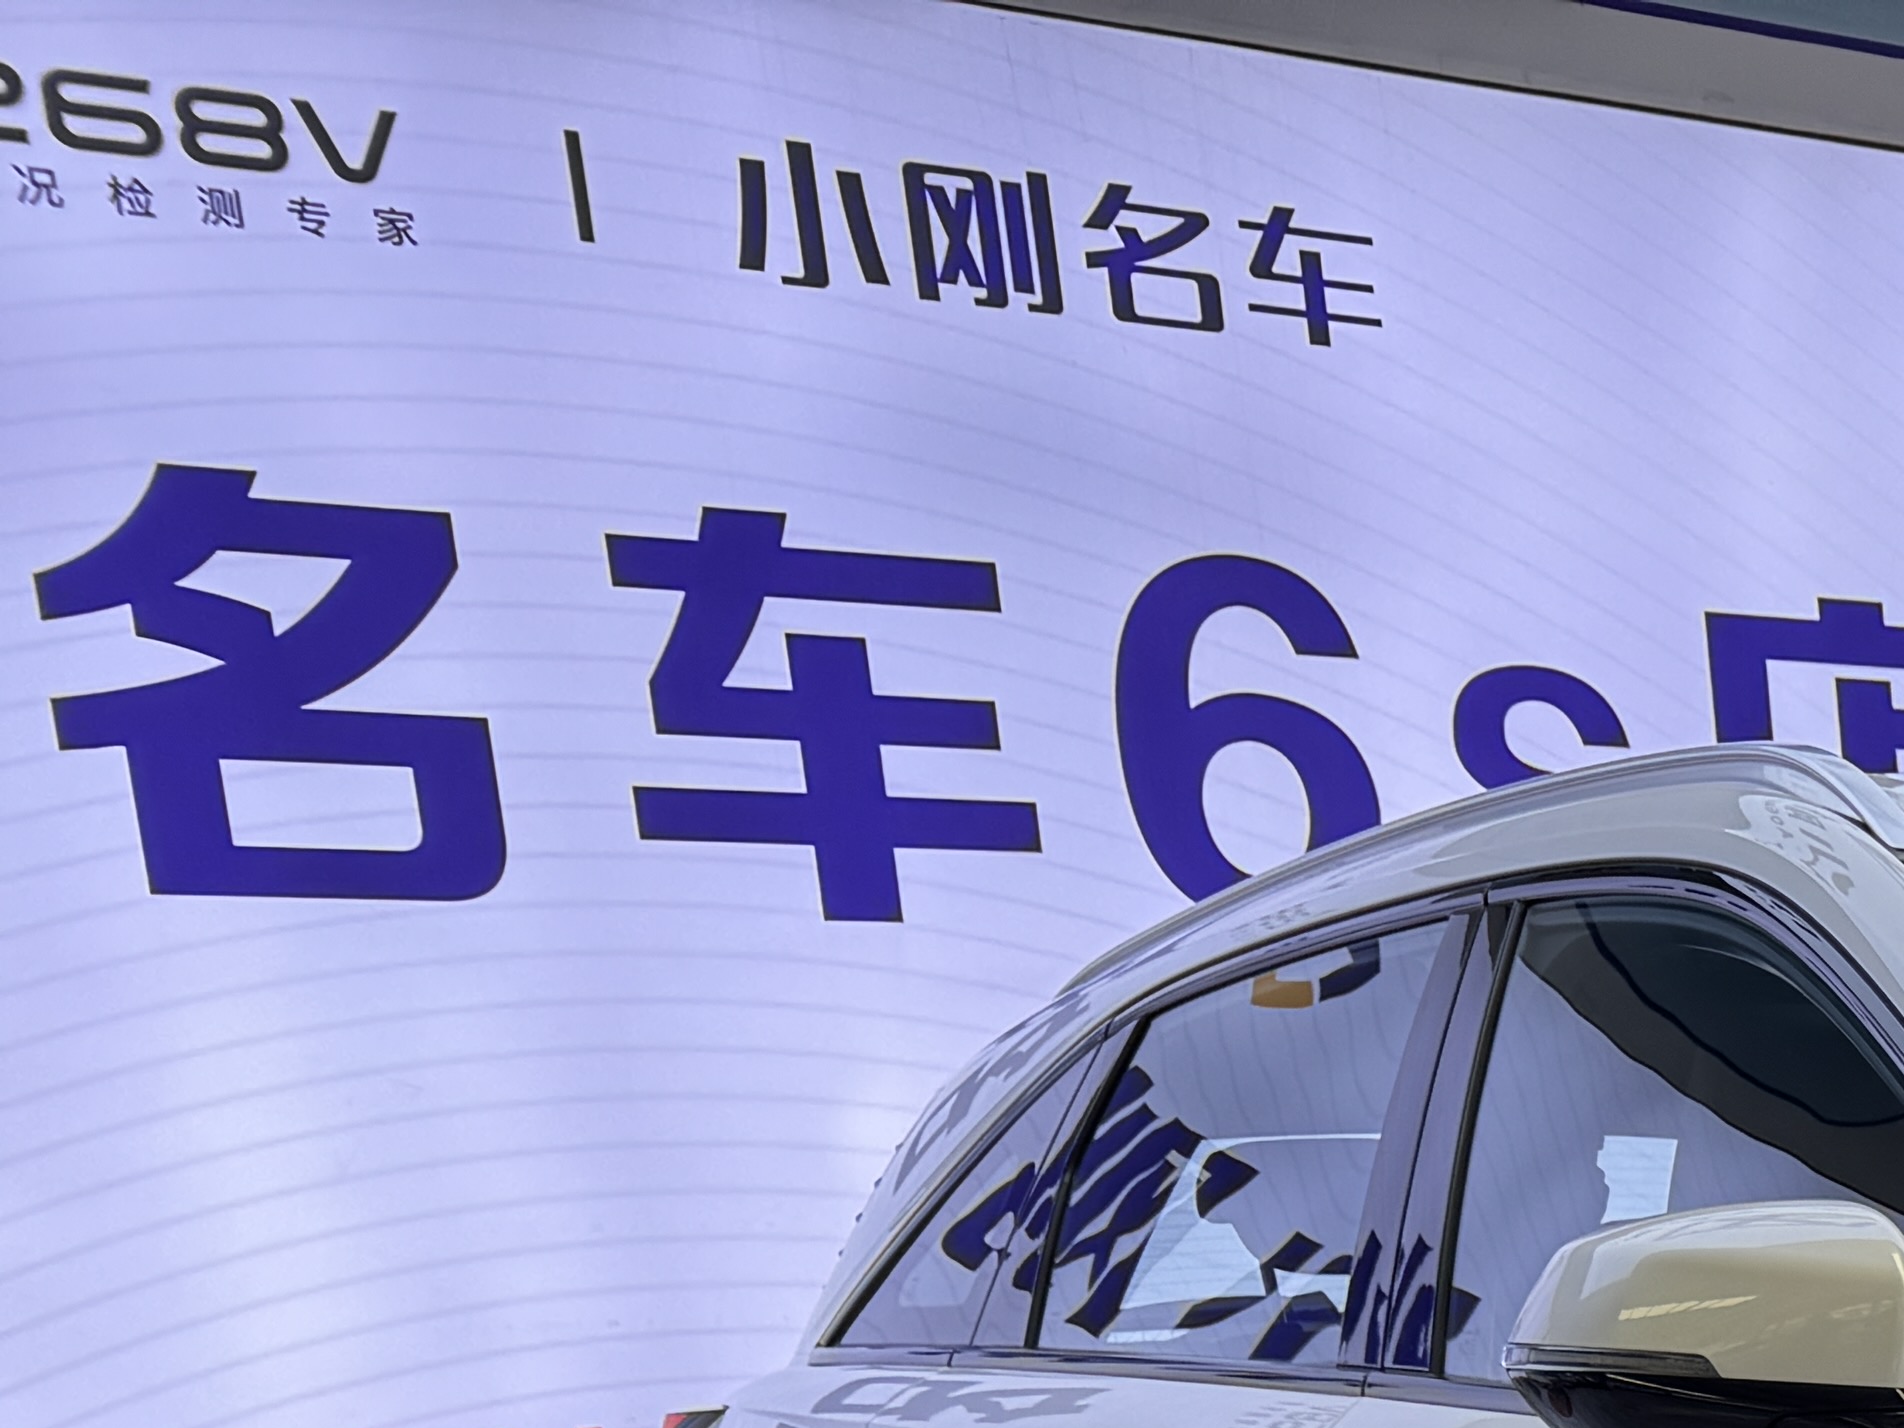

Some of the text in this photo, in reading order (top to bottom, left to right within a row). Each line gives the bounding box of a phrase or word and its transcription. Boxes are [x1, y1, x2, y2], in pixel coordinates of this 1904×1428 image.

[0, 62, 396, 184] 68V
[10, 162, 418, 248] 况检测专家
[736, 140, 1383, 348] 小刚名车
